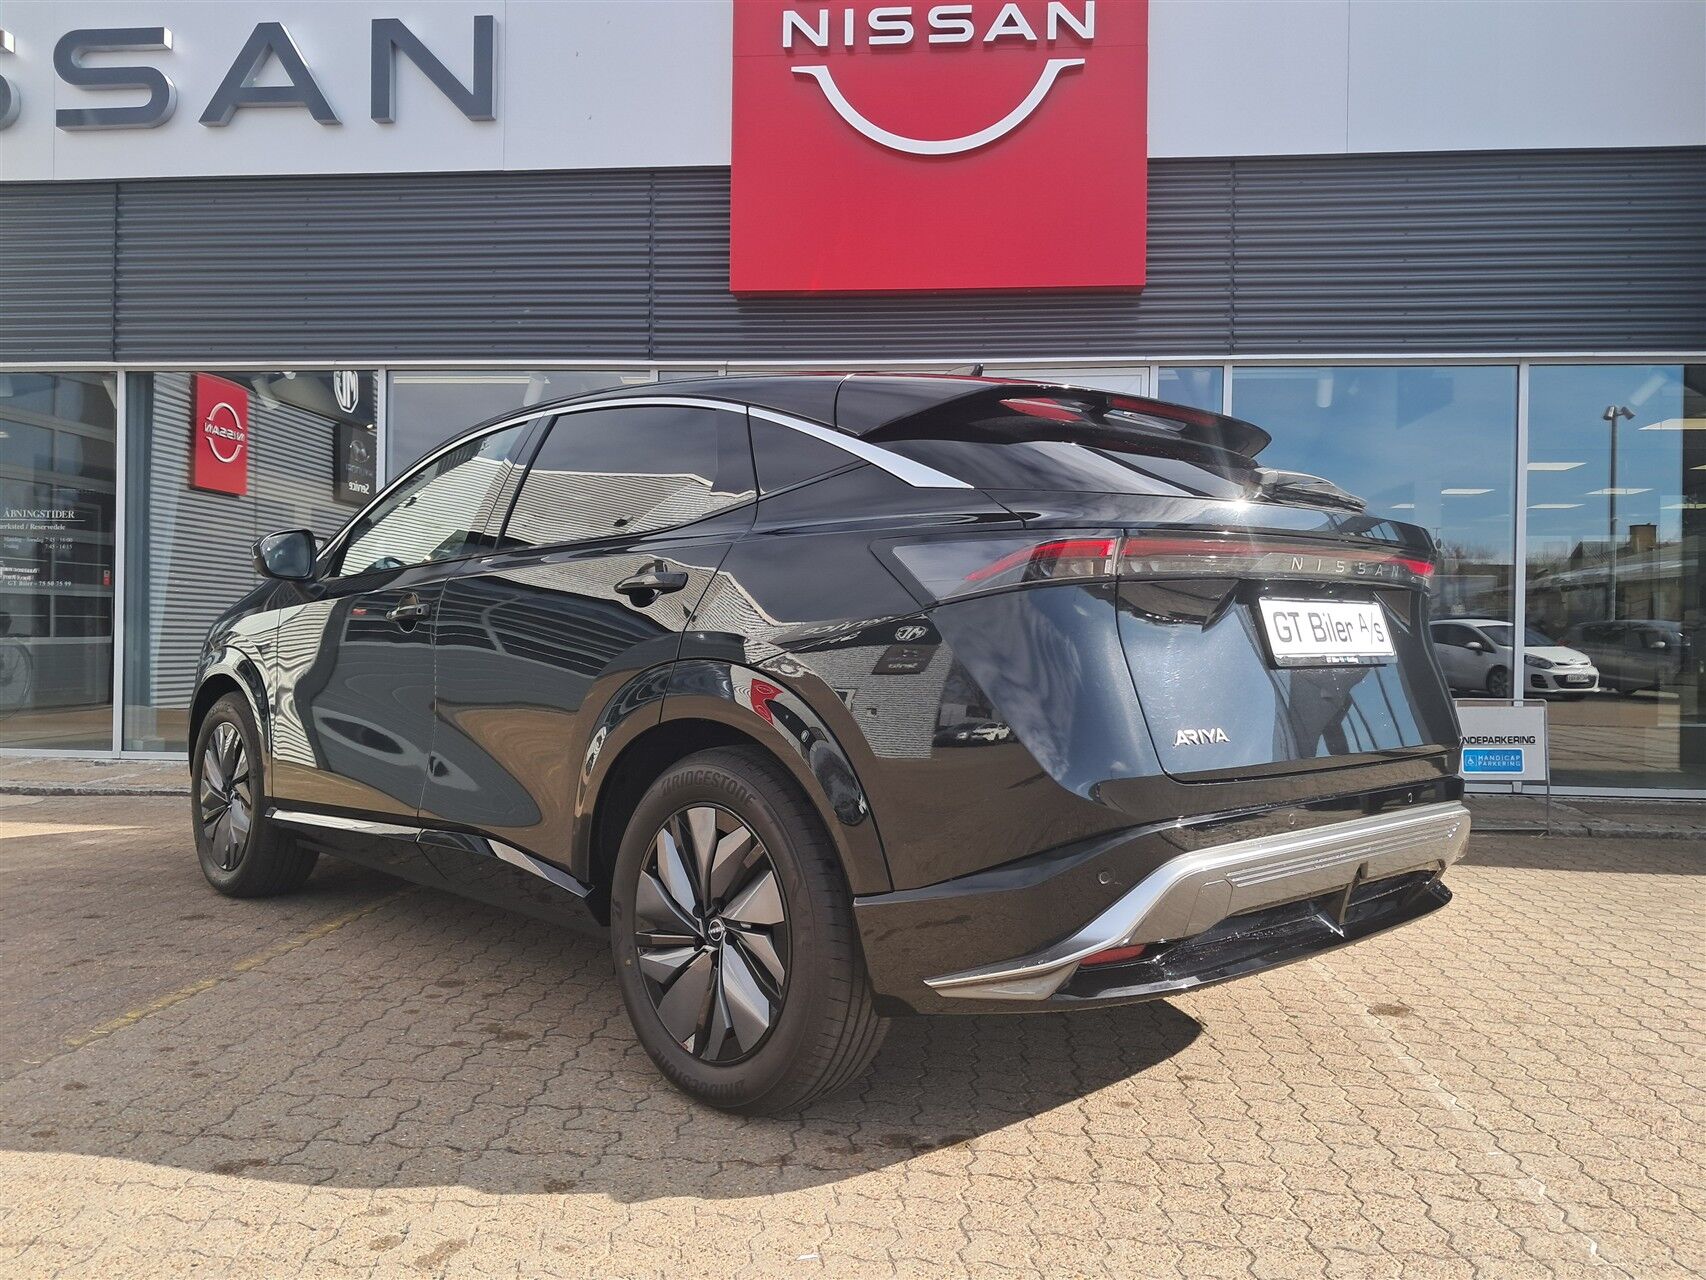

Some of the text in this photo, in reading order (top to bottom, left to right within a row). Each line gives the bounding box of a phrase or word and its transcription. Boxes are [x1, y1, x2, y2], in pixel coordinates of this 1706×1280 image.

[783, 0, 1095, 48] NISSAN
[0, 14, 497, 131] SAN
[3, 507, 75, 518] ÅBNINGSTIDER
[1291, 557, 1399, 578] NISSAN
[1273, 611, 1302, 643] GT
[1308, 612, 1354, 643] Biler
[1173, 727, 1231, 747] ARIYA
